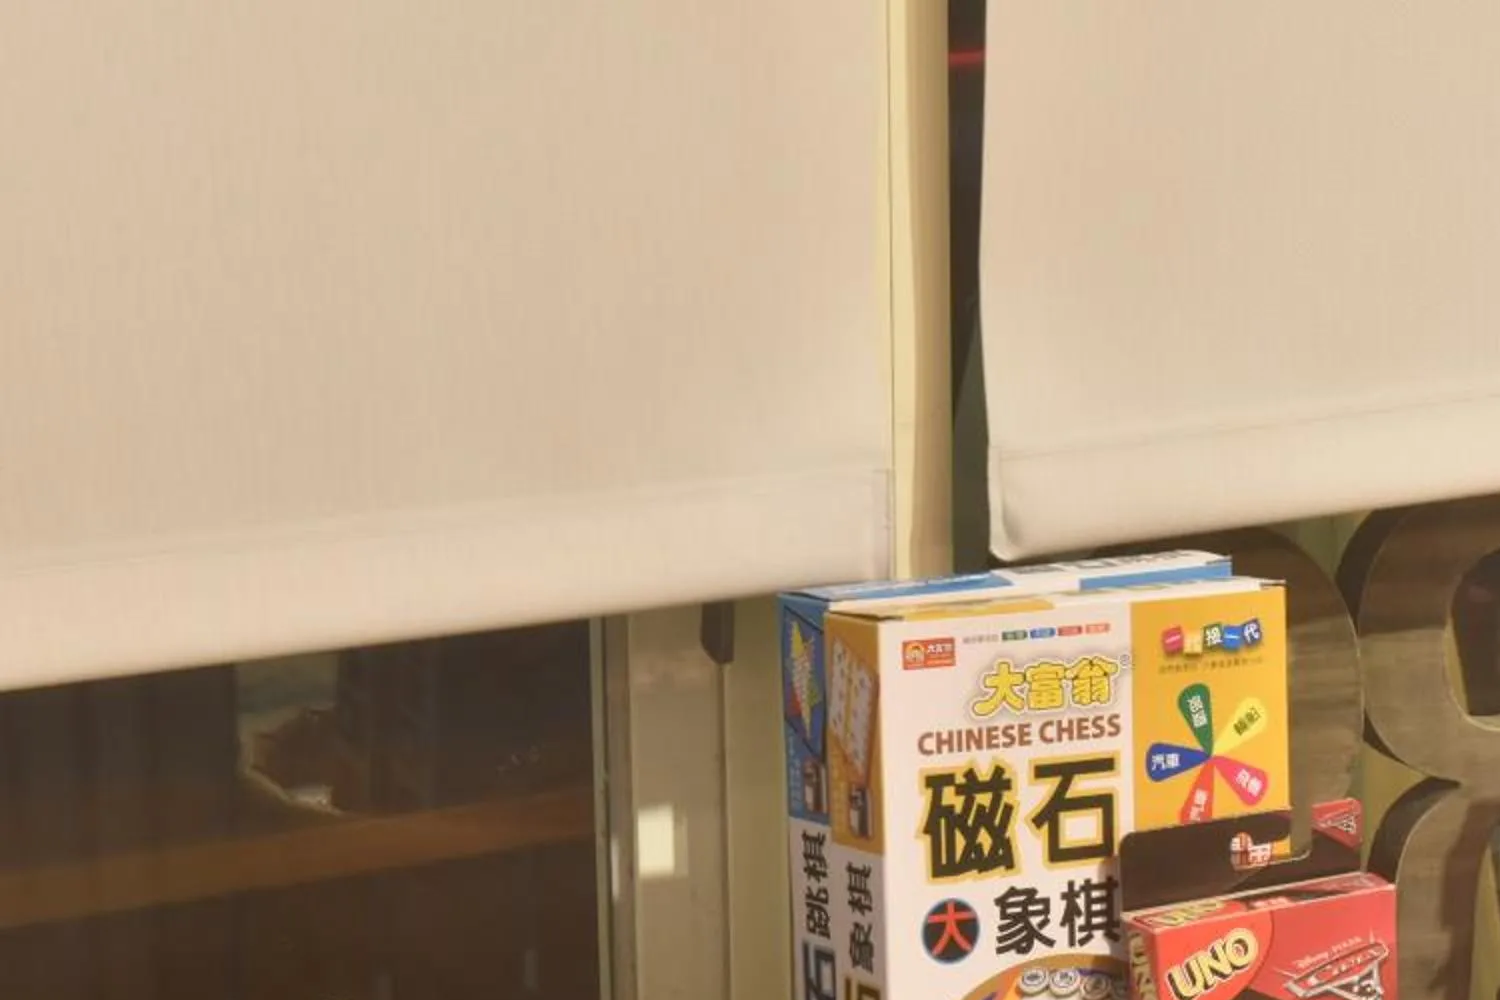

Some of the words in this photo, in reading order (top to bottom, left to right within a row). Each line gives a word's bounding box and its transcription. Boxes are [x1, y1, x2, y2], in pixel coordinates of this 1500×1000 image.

[972, 656, 1119, 717] 大富翁
[918, 722, 1032, 756] CHINESE
[1038, 714, 1121, 744] CHESS
[922, 757, 1116, 880] 磁石
[929, 907, 973, 956] 大
[994, 876, 1121, 955] 象棋
